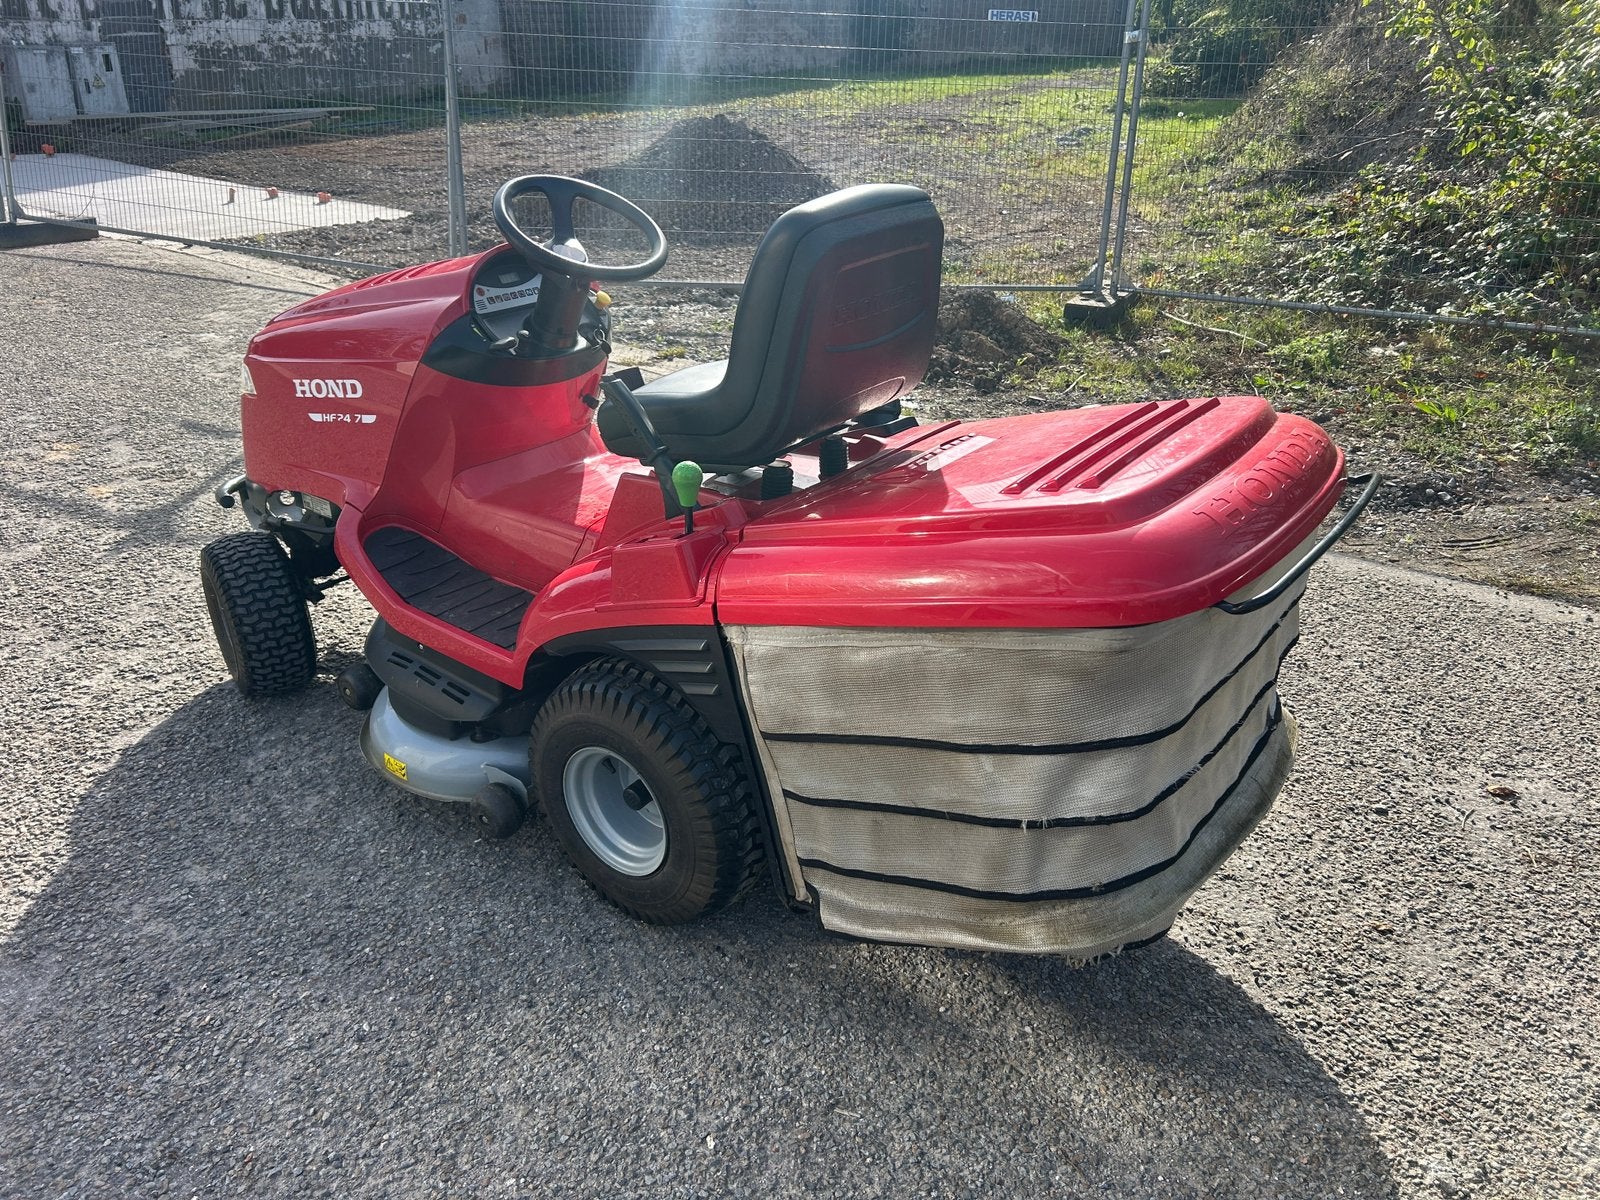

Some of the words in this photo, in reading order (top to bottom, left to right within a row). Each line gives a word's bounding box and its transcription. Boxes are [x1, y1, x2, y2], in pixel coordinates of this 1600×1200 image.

[991, 10, 1030, 22] HERAS
[292, 378, 363, 399] HOND
[1192, 428, 1328, 536] HONDA
